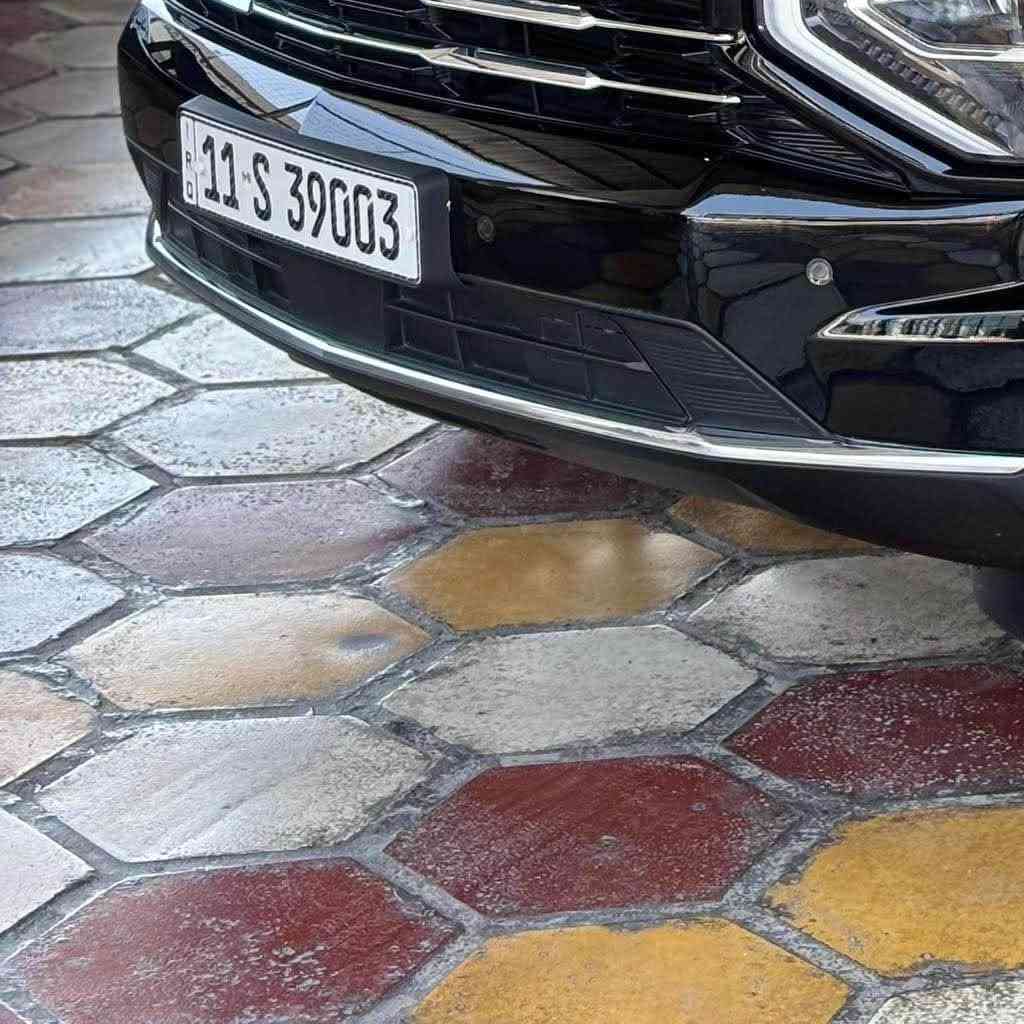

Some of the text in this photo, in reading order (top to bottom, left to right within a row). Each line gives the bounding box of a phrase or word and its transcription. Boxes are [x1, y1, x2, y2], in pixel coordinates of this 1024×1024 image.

[202, 135, 401, 261] 11 S 39003
